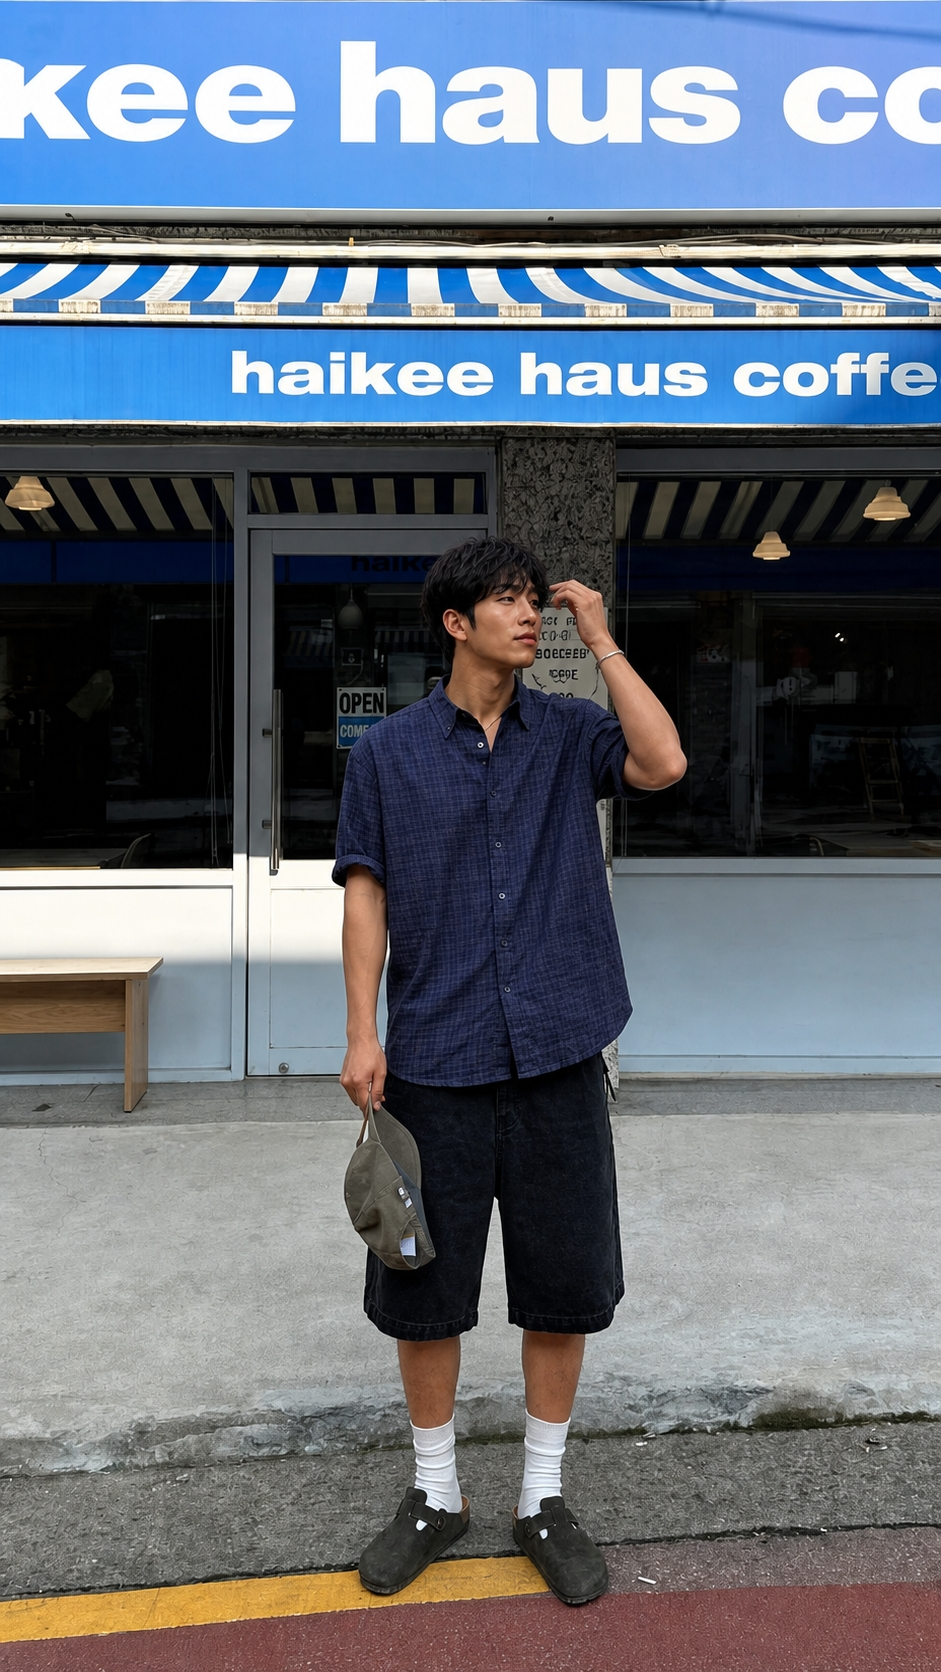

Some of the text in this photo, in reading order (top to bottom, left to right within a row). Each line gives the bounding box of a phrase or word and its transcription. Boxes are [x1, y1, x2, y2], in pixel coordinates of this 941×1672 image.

[0, 40, 941, 144] kee haus co
[231, 350, 938, 397] haikee haus coffe
[339, 692, 385, 715] OPEN
